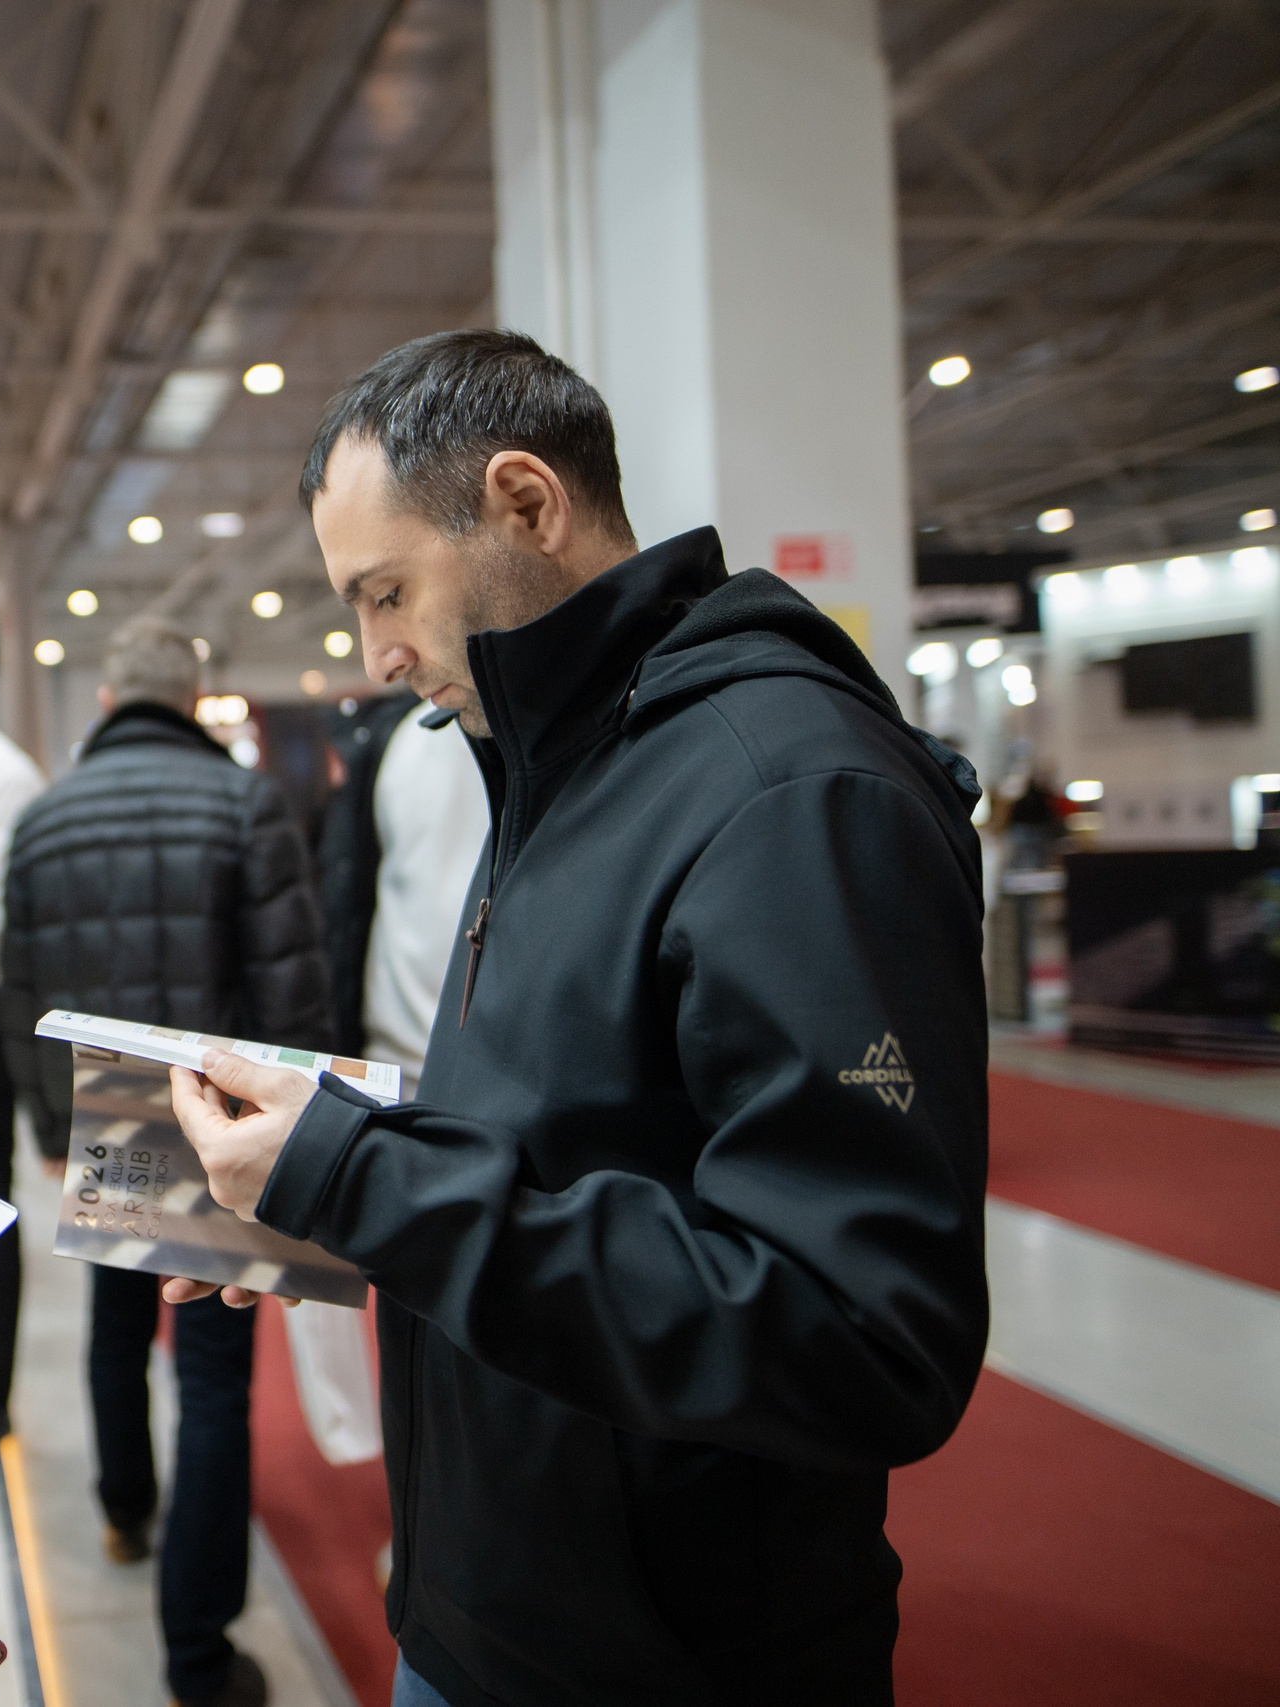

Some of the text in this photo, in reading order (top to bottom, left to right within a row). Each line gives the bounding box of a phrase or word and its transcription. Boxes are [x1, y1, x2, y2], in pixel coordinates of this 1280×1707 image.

[74, 1145, 107, 1231] 2026
[102, 1147, 125, 1233] КОЛЛЕКЦИЯ
[121, 1151, 151, 1237] ARTSIB
[147, 1153, 169, 1239] COLLECTION
